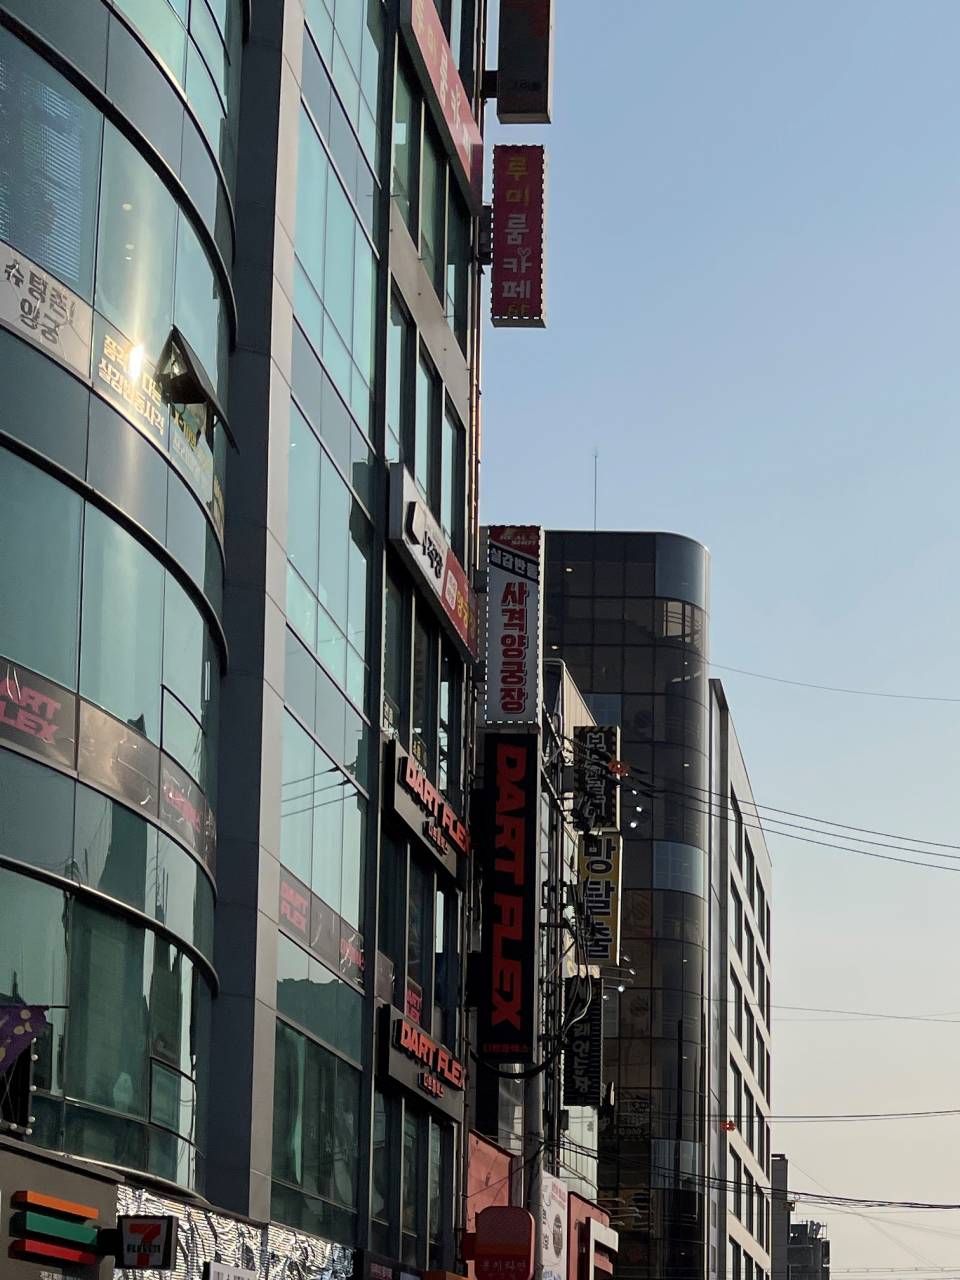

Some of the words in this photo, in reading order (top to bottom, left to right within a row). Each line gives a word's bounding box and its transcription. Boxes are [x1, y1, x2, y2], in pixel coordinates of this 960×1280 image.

[500, 581, 529, 715] 사격양궁장
[404, 756, 441, 817] DART
[494, 745, 527, 886] DART
[491, 891, 524, 1032] FLEX
[400, 1021, 436, 1070] DART
[437, 1047, 466, 1091] FLEX
